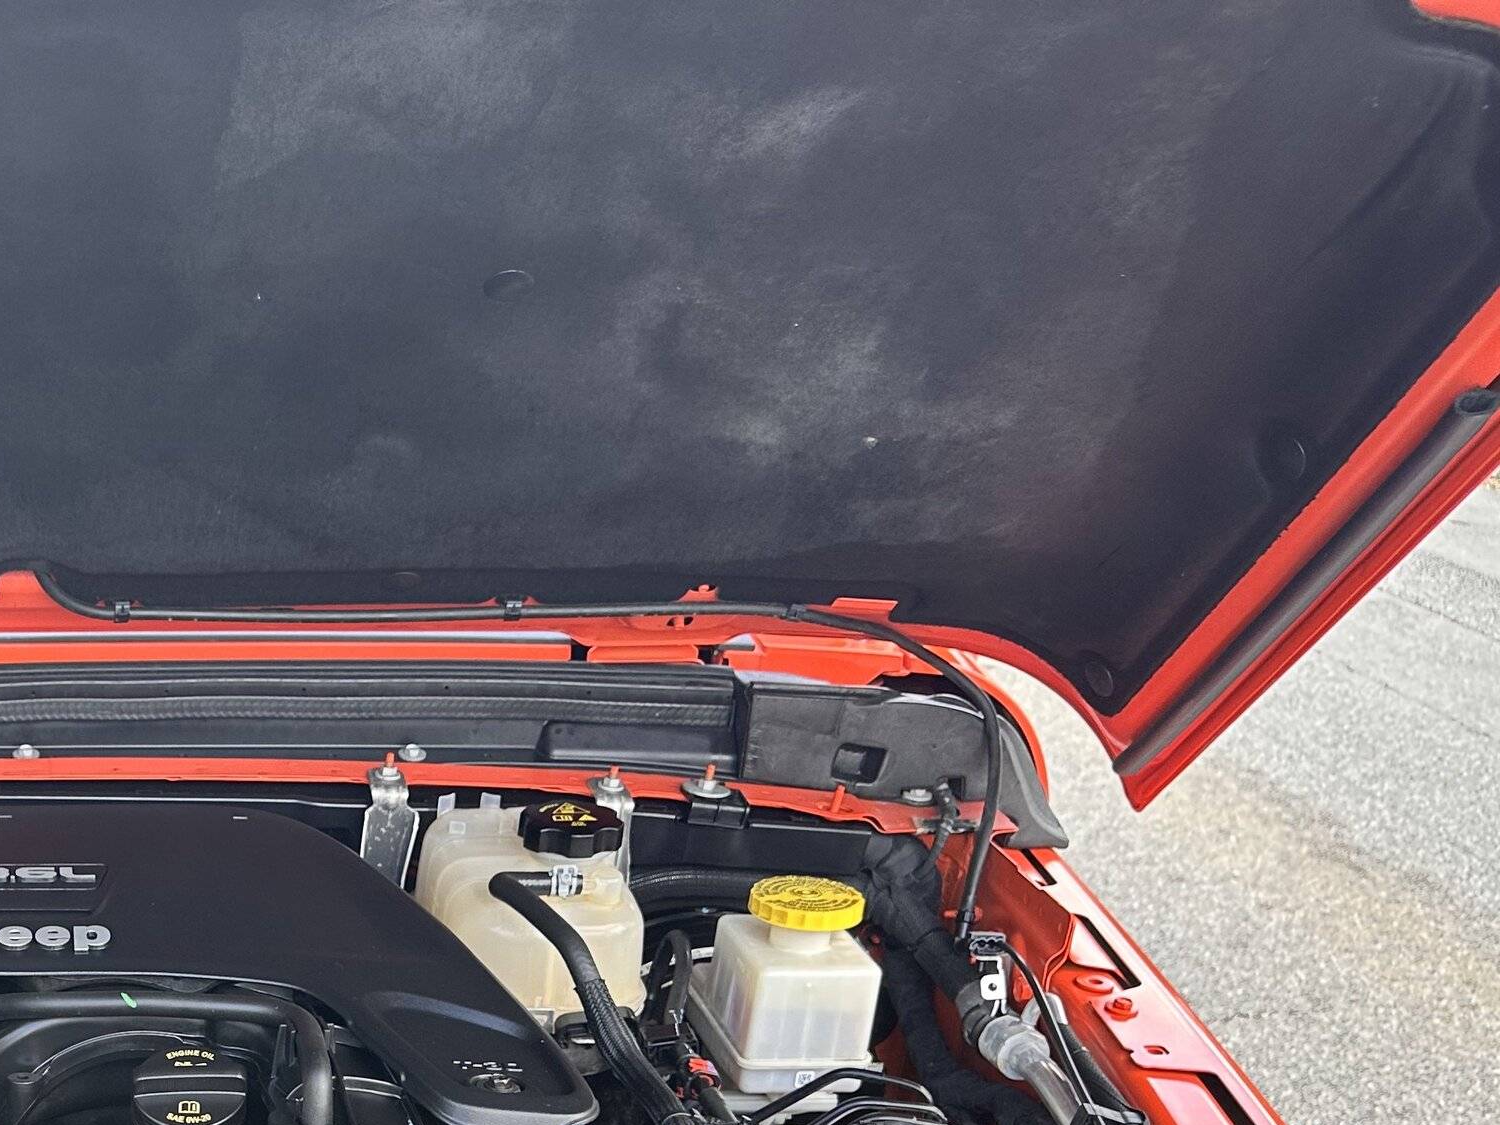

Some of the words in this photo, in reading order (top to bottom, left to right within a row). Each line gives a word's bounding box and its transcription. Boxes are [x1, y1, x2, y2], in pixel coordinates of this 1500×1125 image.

[165, 1049, 201, 1061] ENGINE
[201, 1050, 215, 1061] OIL
[166, 1112, 185, 1123] SAE
[185, 1113, 212, 1124] 0W-20
